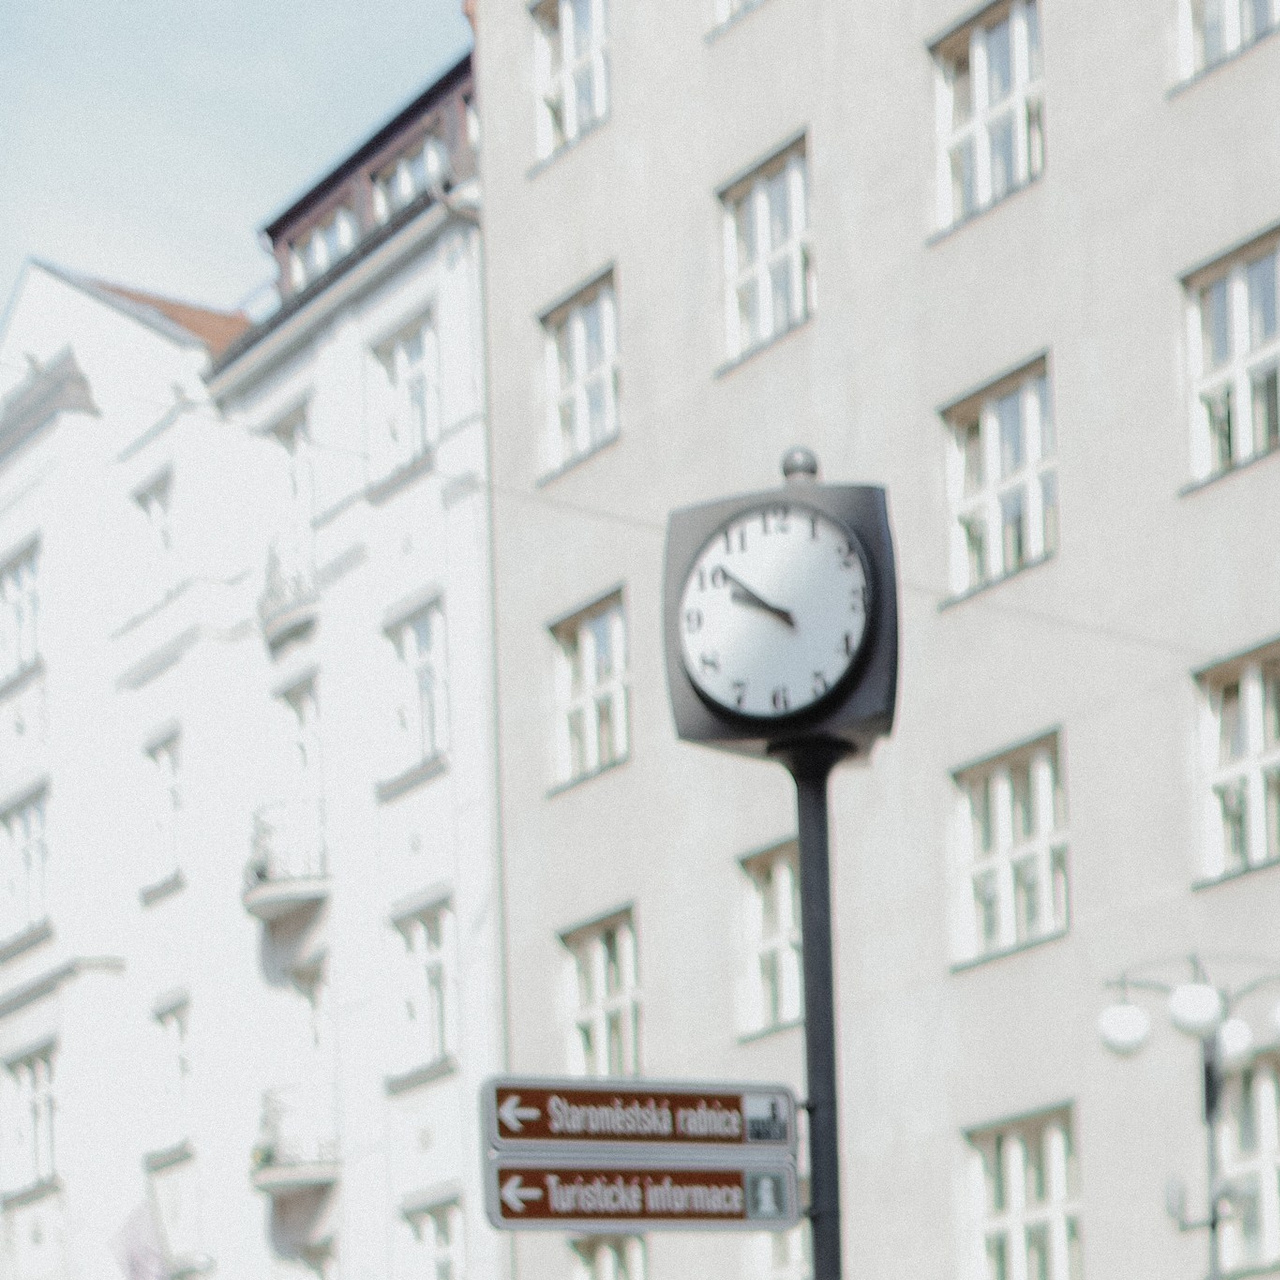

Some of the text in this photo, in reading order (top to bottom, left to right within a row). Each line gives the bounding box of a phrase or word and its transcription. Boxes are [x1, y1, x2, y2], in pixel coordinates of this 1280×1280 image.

[723, 527, 746, 554] 11
[548, 1095, 741, 1137] Staroměstská radnice
[546, 1174, 743, 1214] Turistické informace
